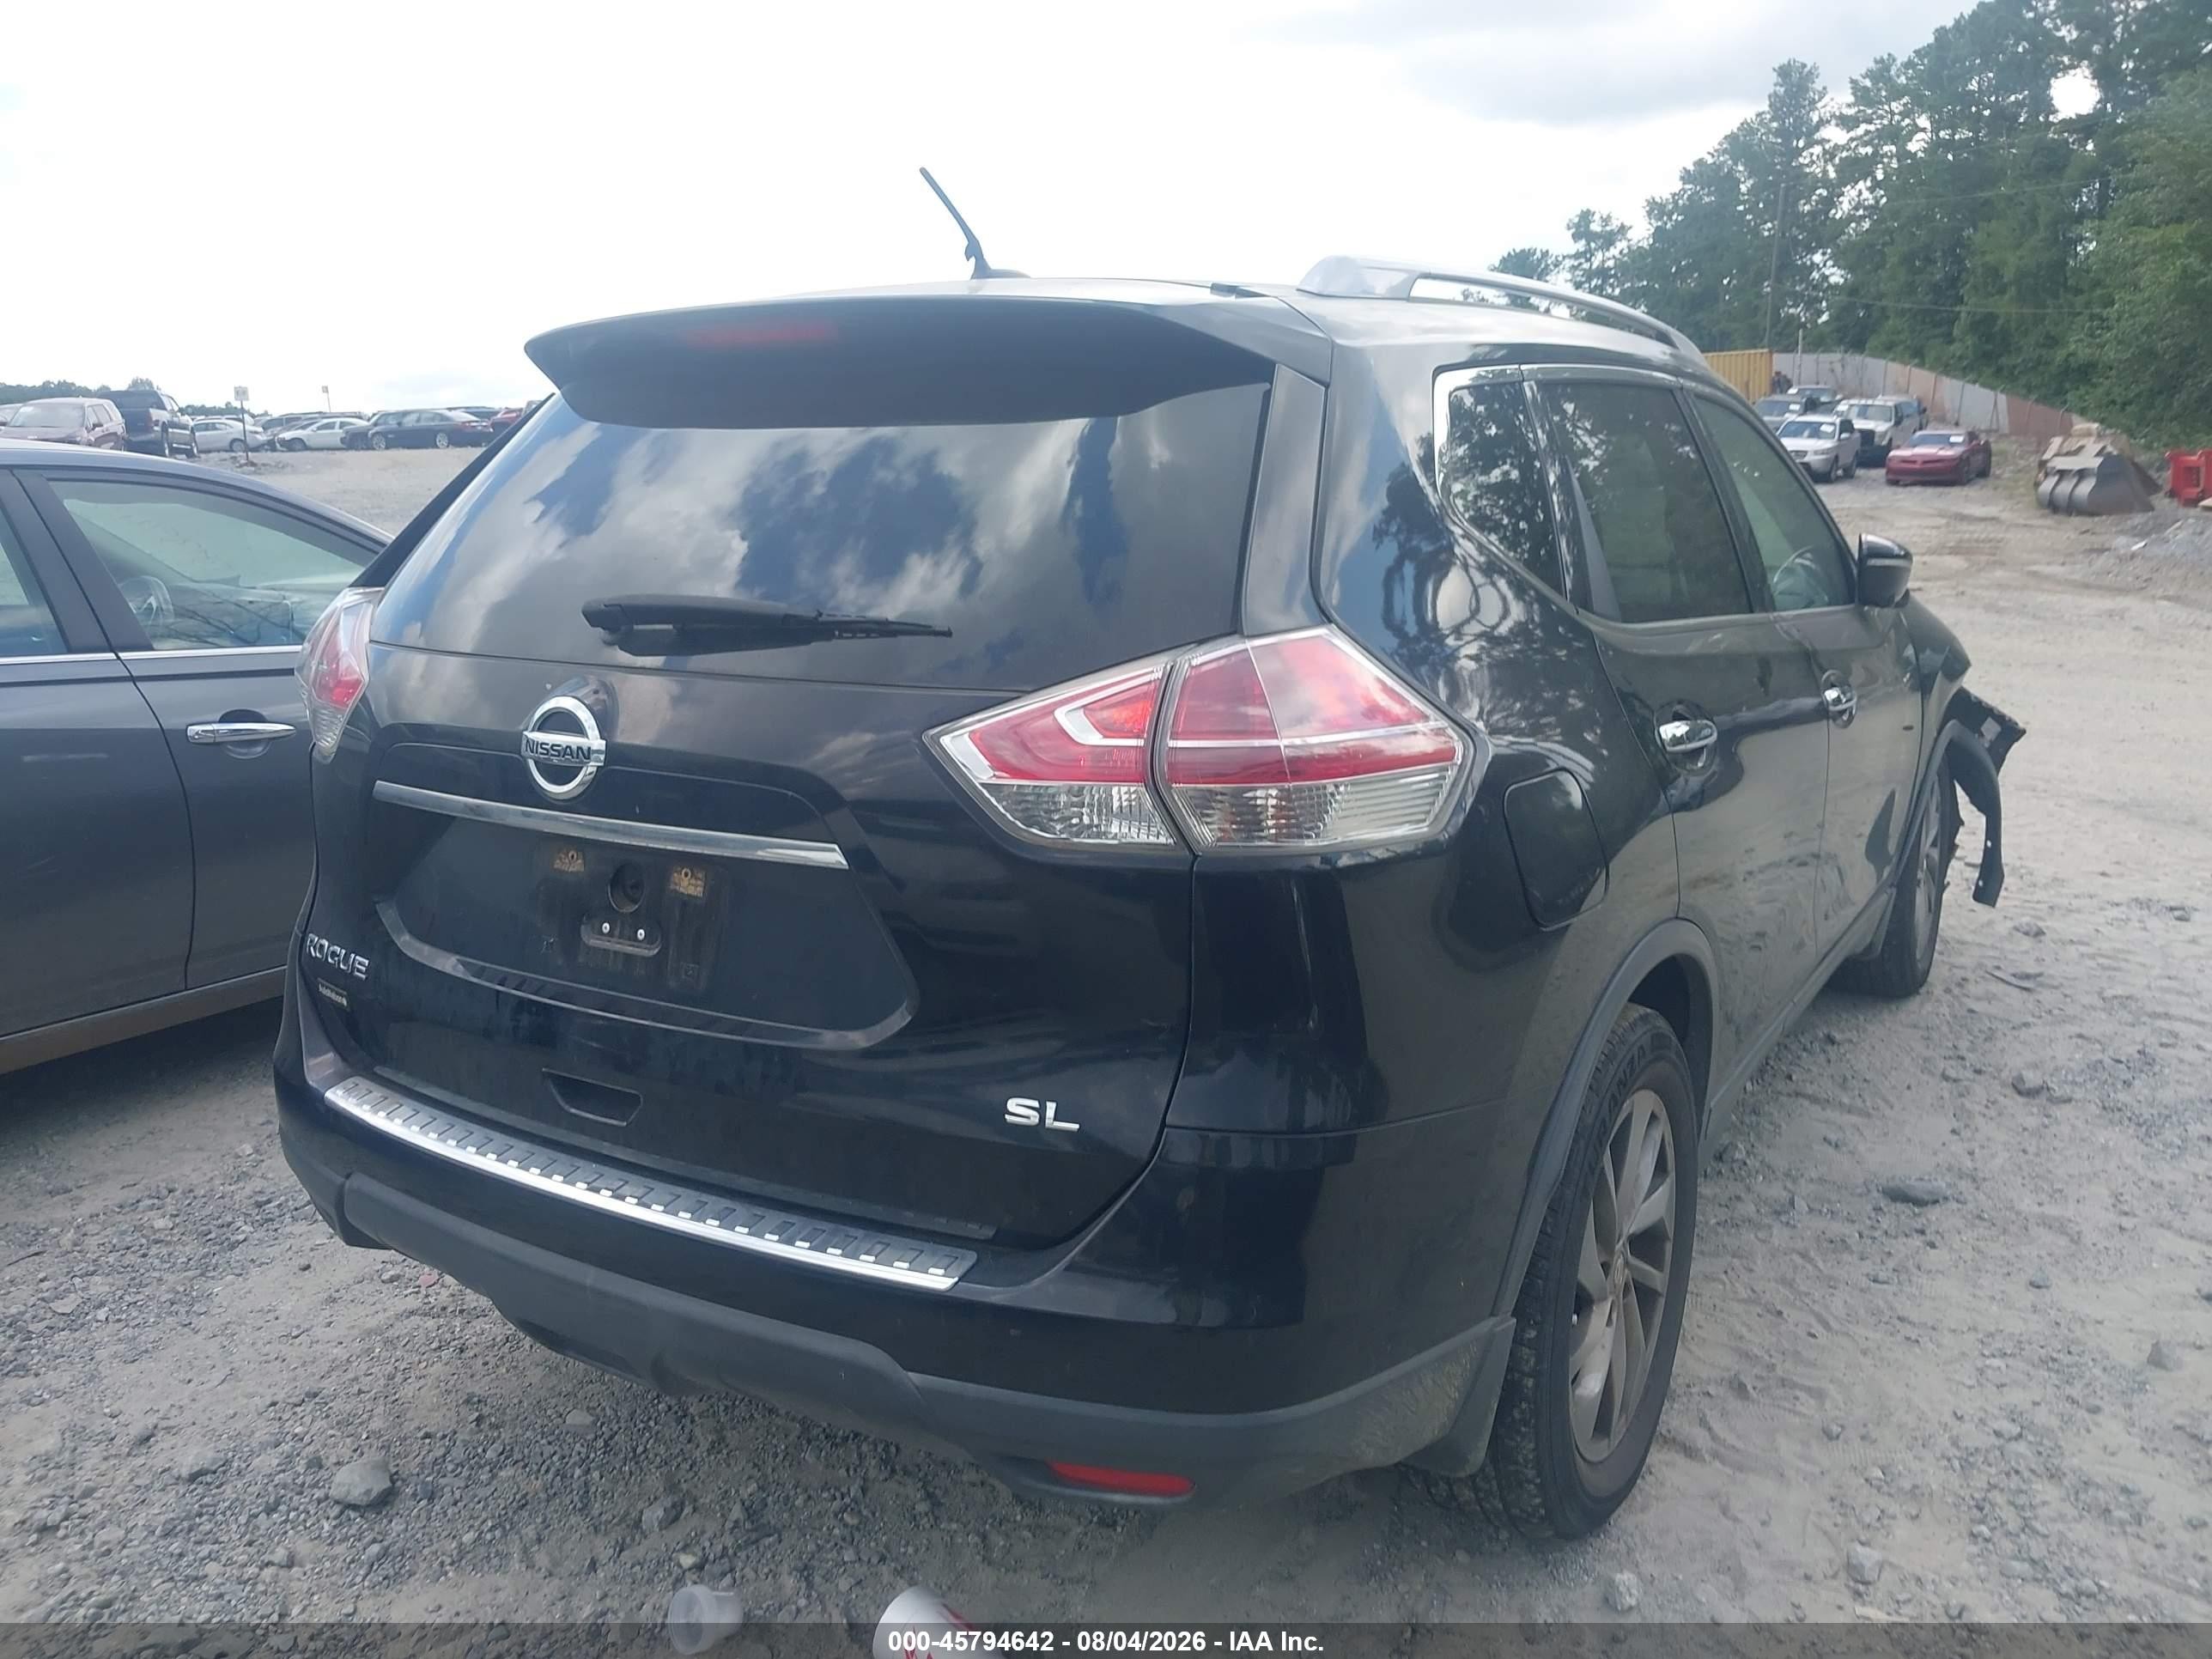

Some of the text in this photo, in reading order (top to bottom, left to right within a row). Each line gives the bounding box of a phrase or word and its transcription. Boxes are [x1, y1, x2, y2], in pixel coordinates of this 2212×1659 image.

[525, 738, 592, 761] NISSAN
[306, 933, 369, 981] ROGUE
[1004, 1097, 1080, 1133] SL
